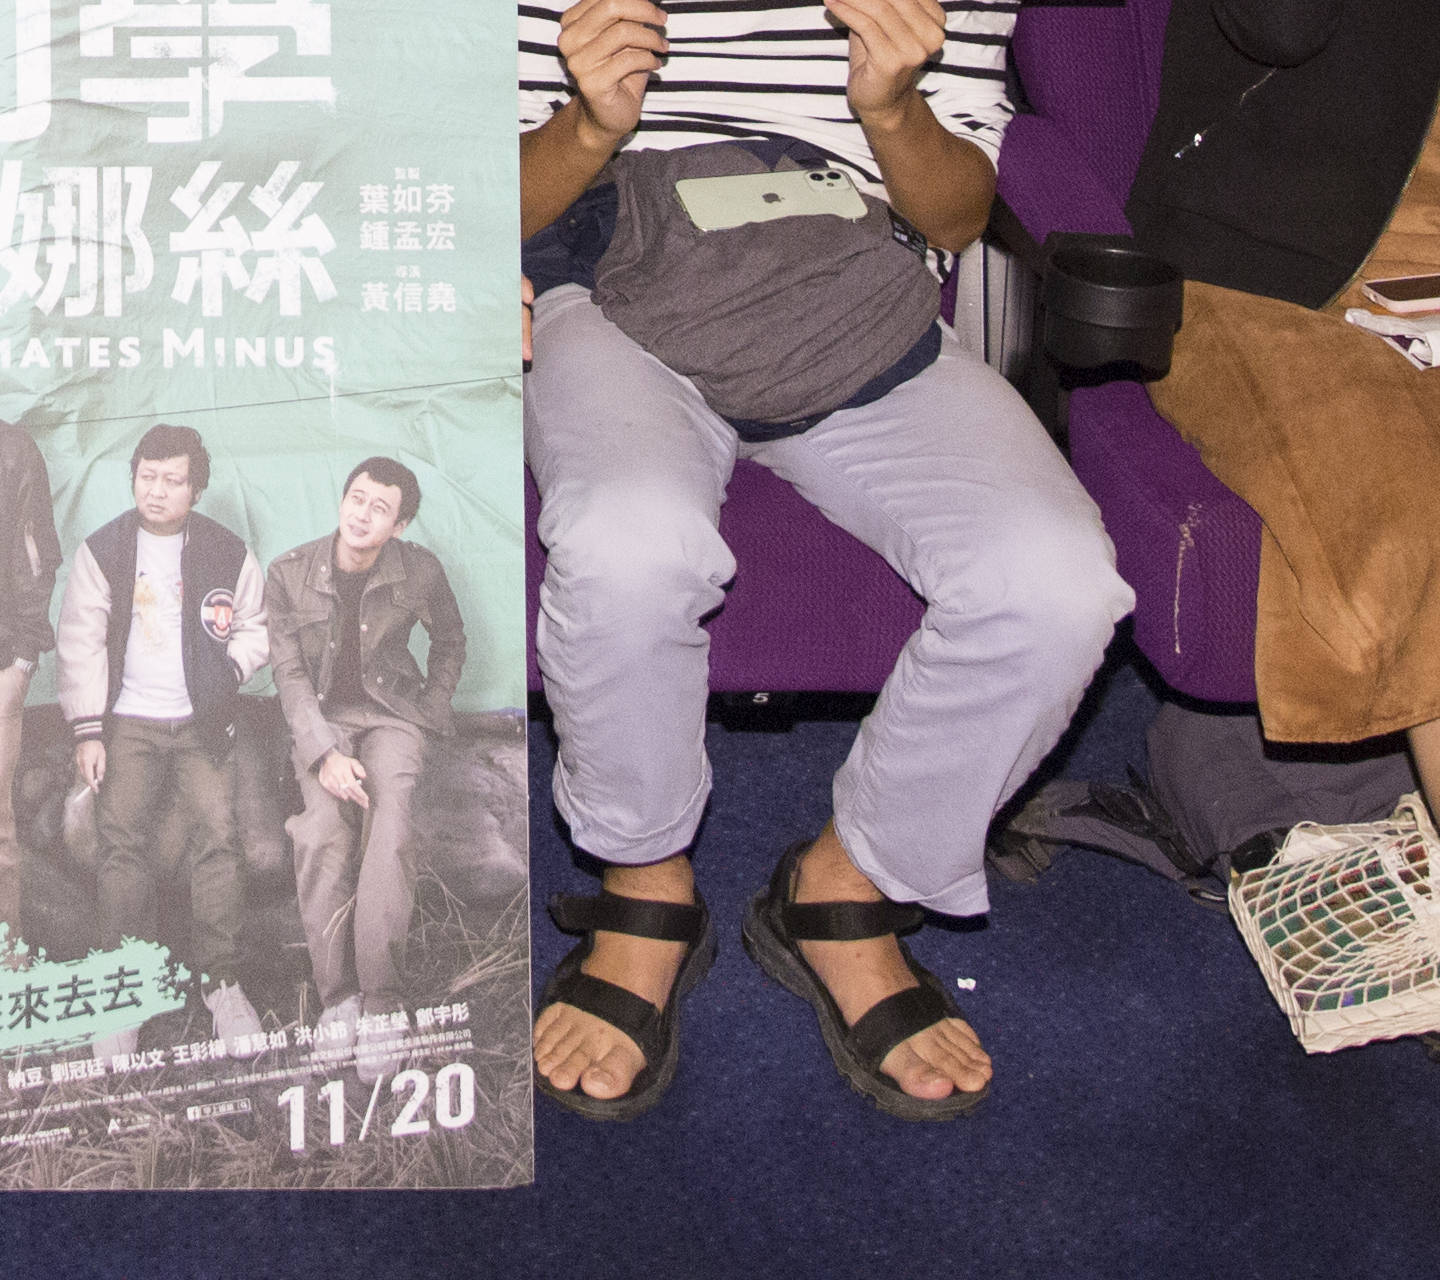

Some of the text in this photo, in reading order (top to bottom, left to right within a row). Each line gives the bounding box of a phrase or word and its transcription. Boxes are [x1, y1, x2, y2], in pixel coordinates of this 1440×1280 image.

[358, 182, 456, 215] 葉如芬
[359, 220, 457, 251] 鍾孟宏
[360, 281, 457, 313] 黃信堯
[162, 327, 337, 371] MINUS
[276, 1062, 476, 1152] 11/20
